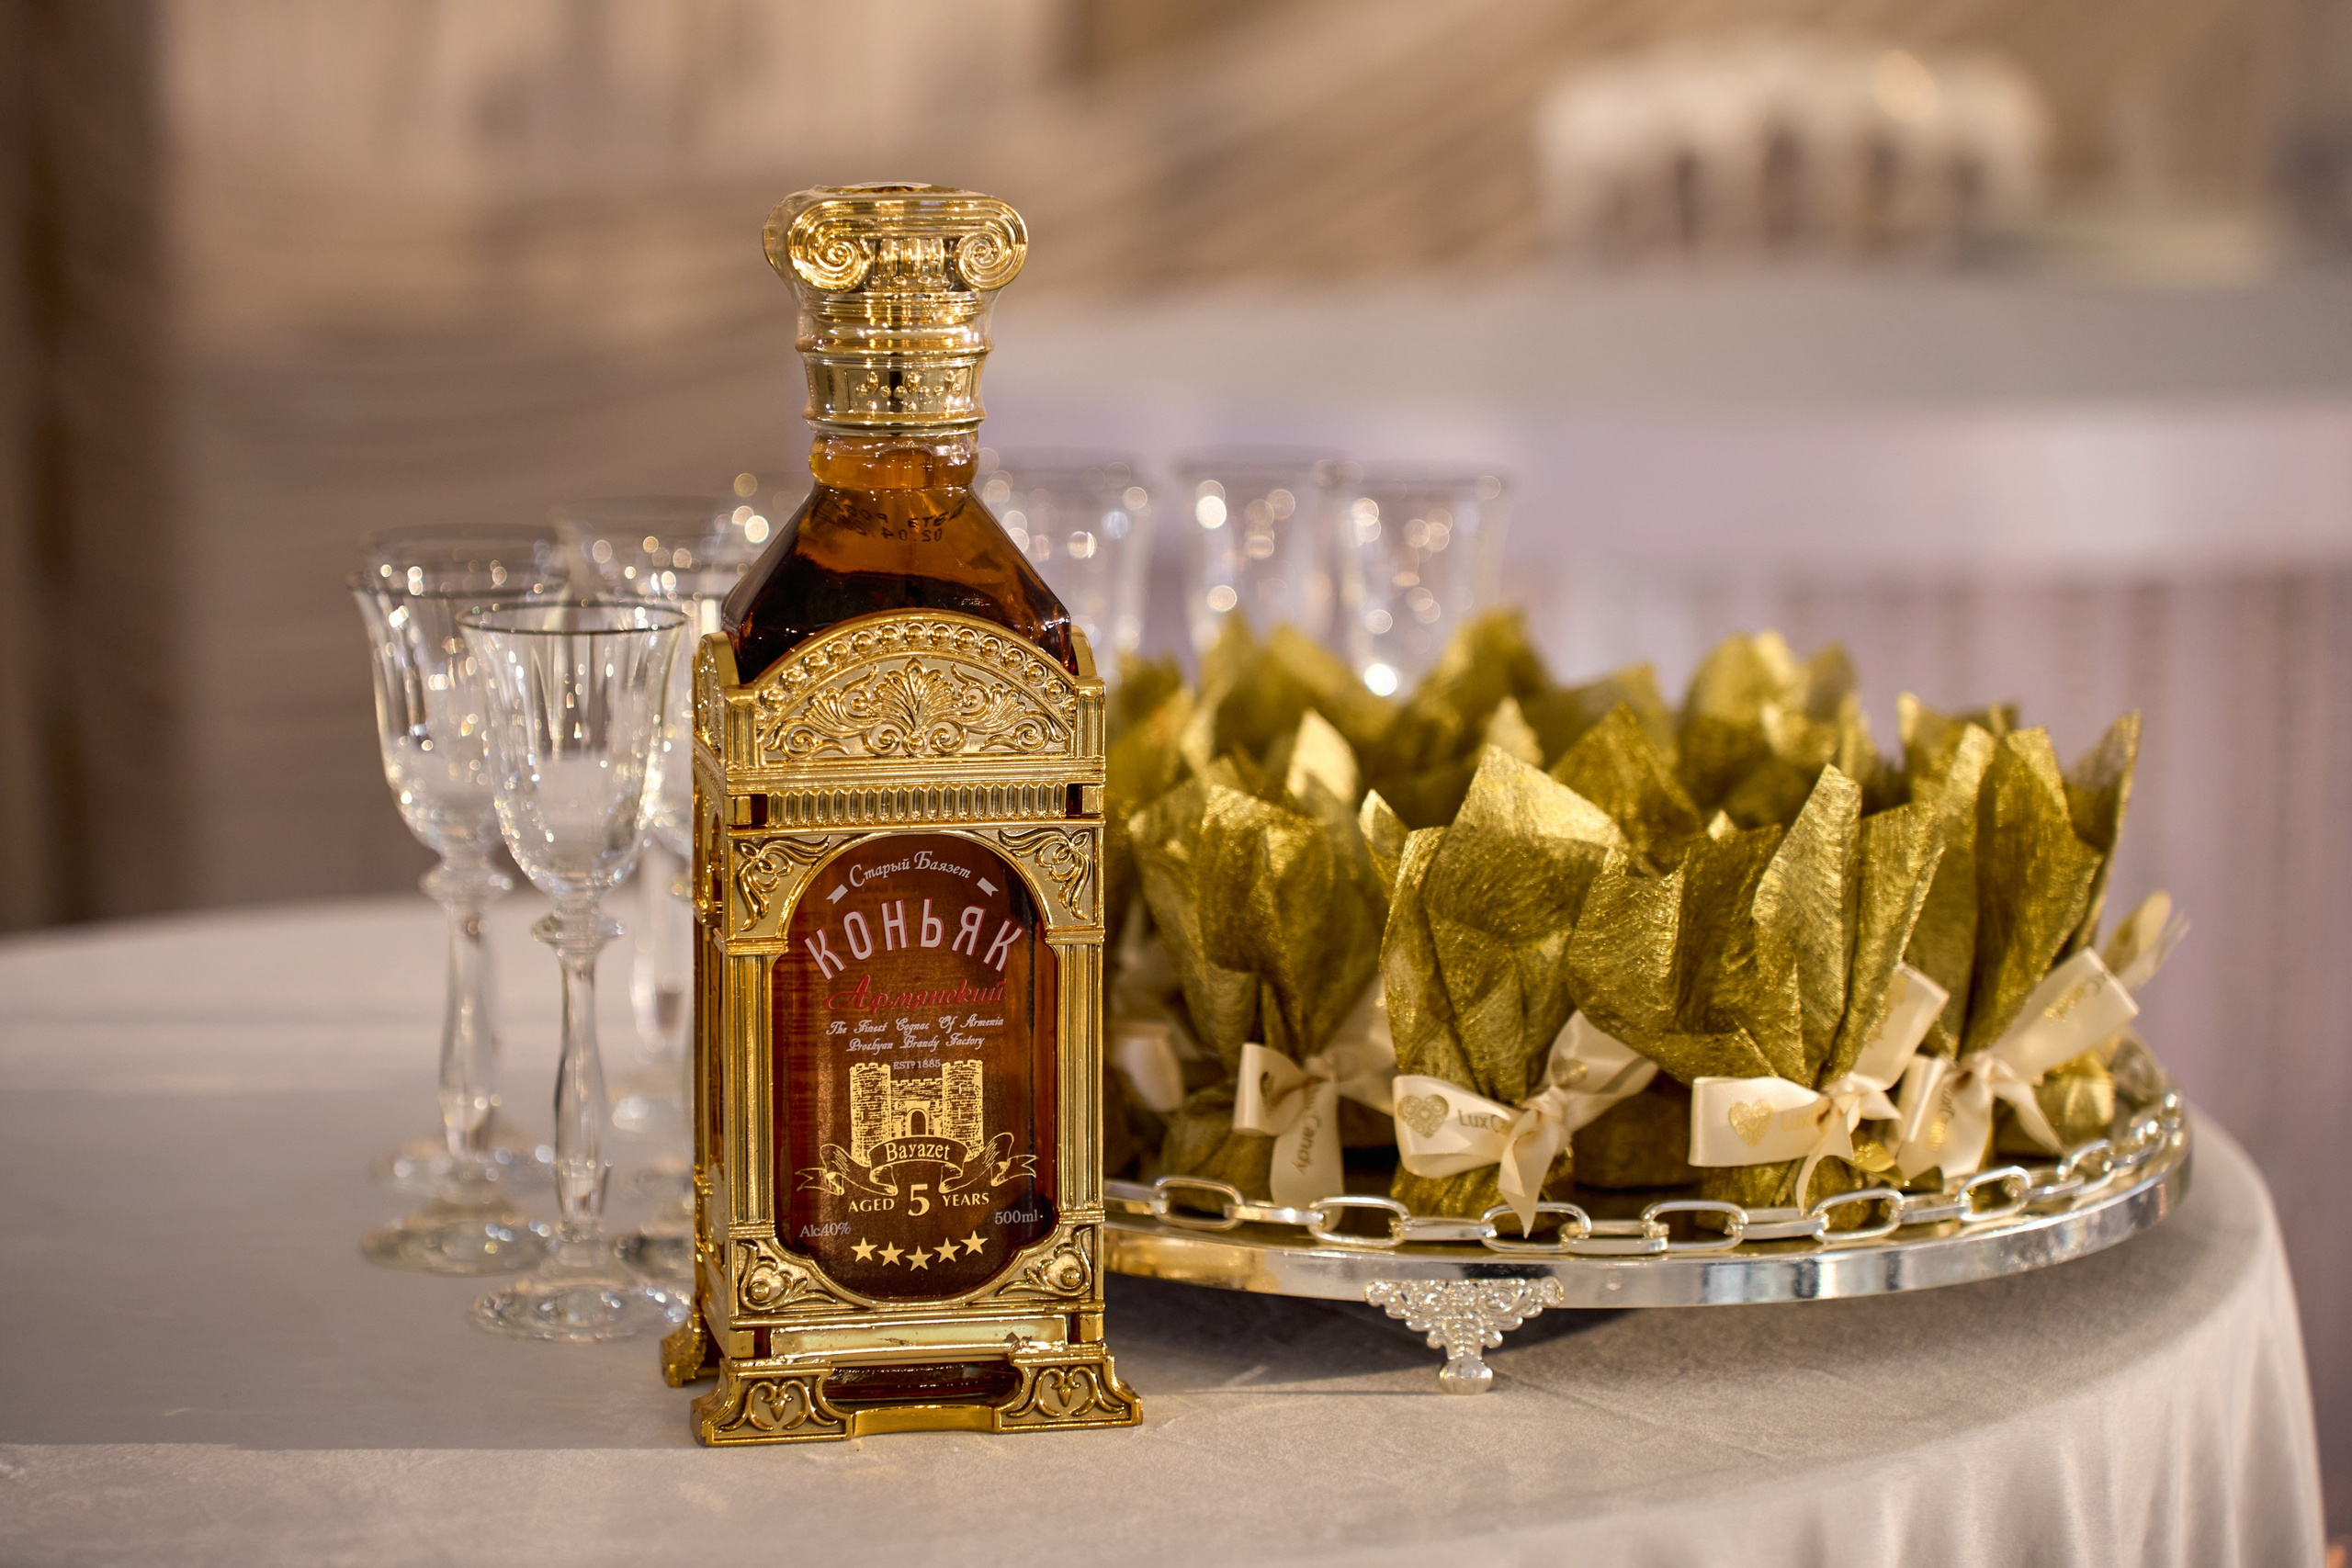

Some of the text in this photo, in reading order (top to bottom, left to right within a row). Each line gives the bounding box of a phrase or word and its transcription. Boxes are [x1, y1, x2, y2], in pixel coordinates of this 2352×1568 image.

[849, 851, 971, 887] Старый Баязет
[804, 898, 1024, 980] КОНЬЯК
[824, 975, 1007, 1013] Армянский
[826, 1013, 1003, 1036] The Finest Cognac Of Armenia
[846, 1032, 985, 1055] Proshyan Brandy Factory
[917, 1058, 942, 1069] 1885
[884, 1141, 951, 1162] Bayazet
[848, 1183, 989, 1216] AGED 5 YEARS
[994, 1209, 1038, 1224] 500ml
